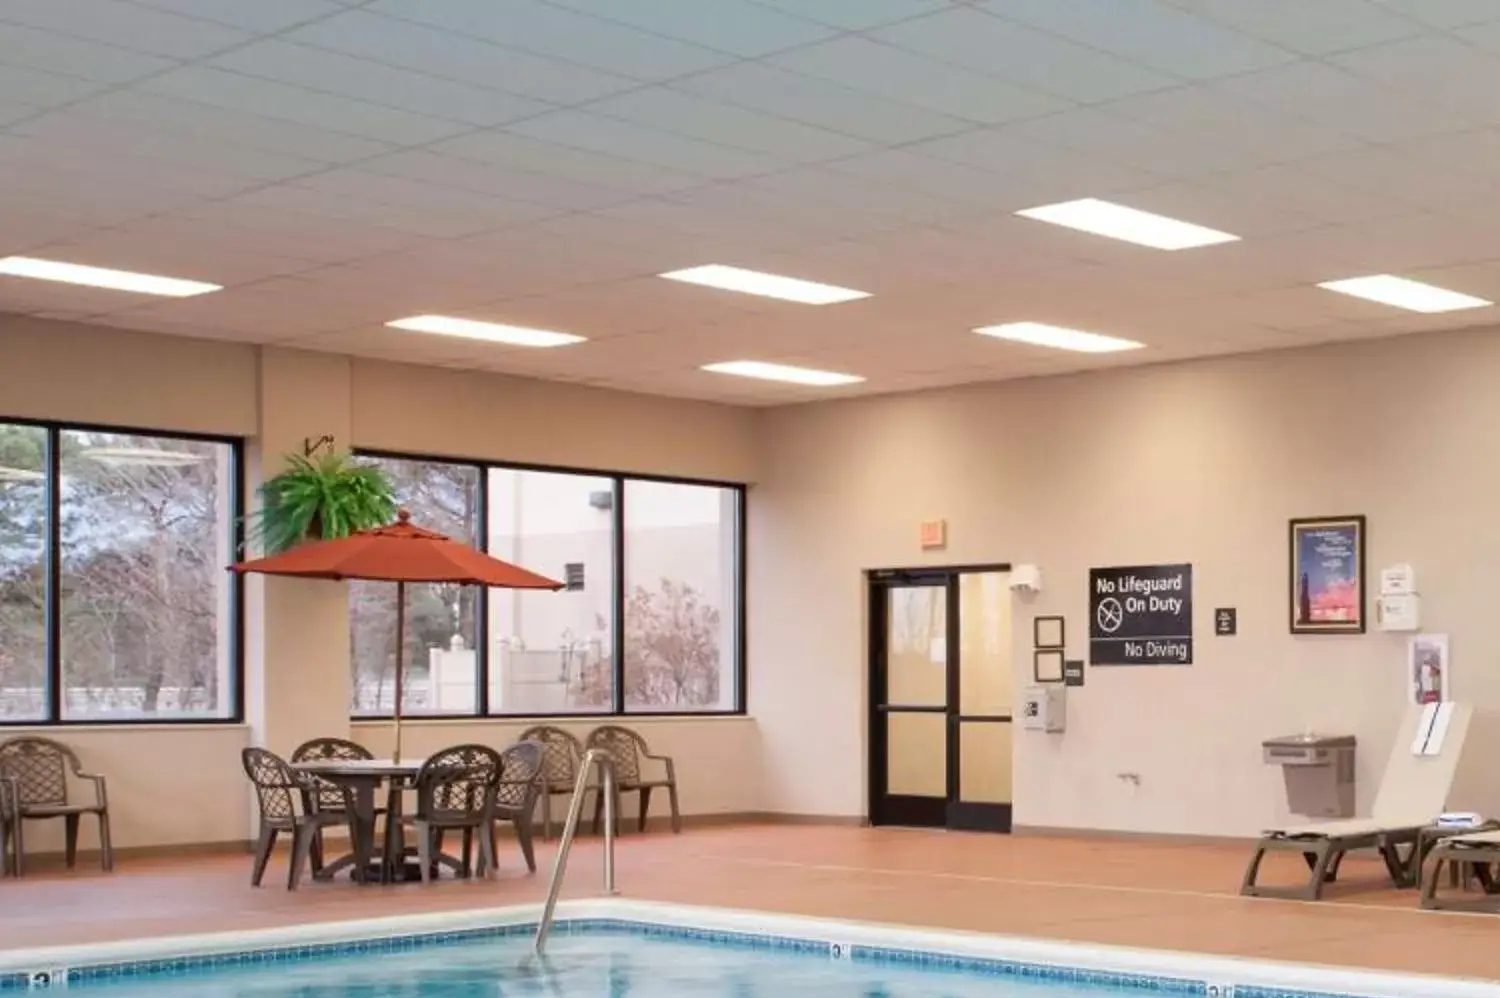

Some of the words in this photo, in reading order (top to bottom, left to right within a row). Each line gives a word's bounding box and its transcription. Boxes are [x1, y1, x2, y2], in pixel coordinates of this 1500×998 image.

[1096, 577, 1115, 594] No
[1119, 575, 1182, 595] Lifeguard
[1125, 597, 1145, 613] On
[1150, 596, 1182, 614] Duty
[1124, 642, 1143, 657] No
[1147, 641, 1187, 659] Diving
